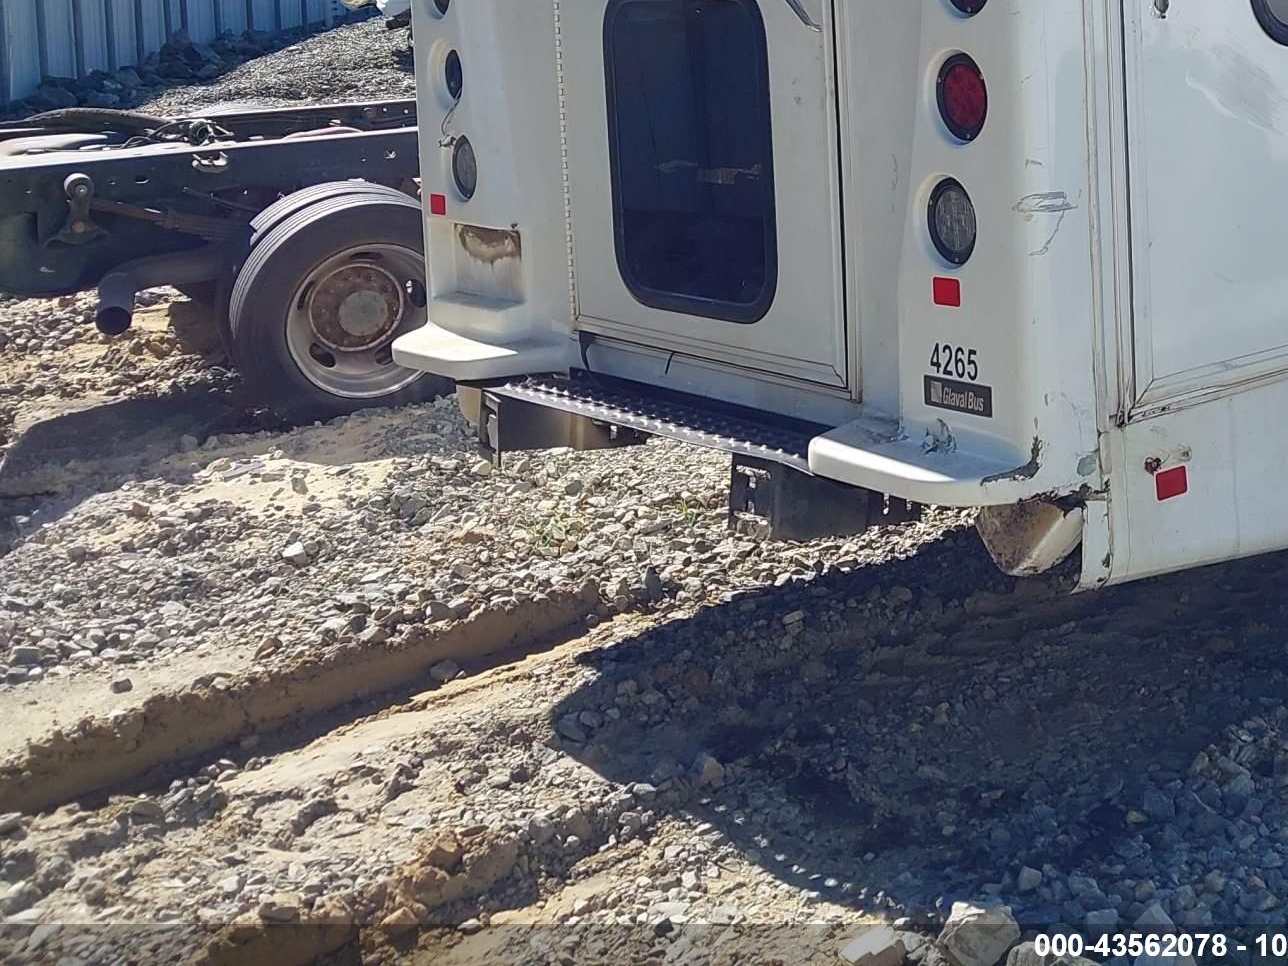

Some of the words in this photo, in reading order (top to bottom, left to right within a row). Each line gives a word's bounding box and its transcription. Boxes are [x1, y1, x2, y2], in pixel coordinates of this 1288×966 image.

[930, 342, 978, 381] 4265
[943, 387, 967, 408] Glaval
[968, 391, 984, 411] Bus
